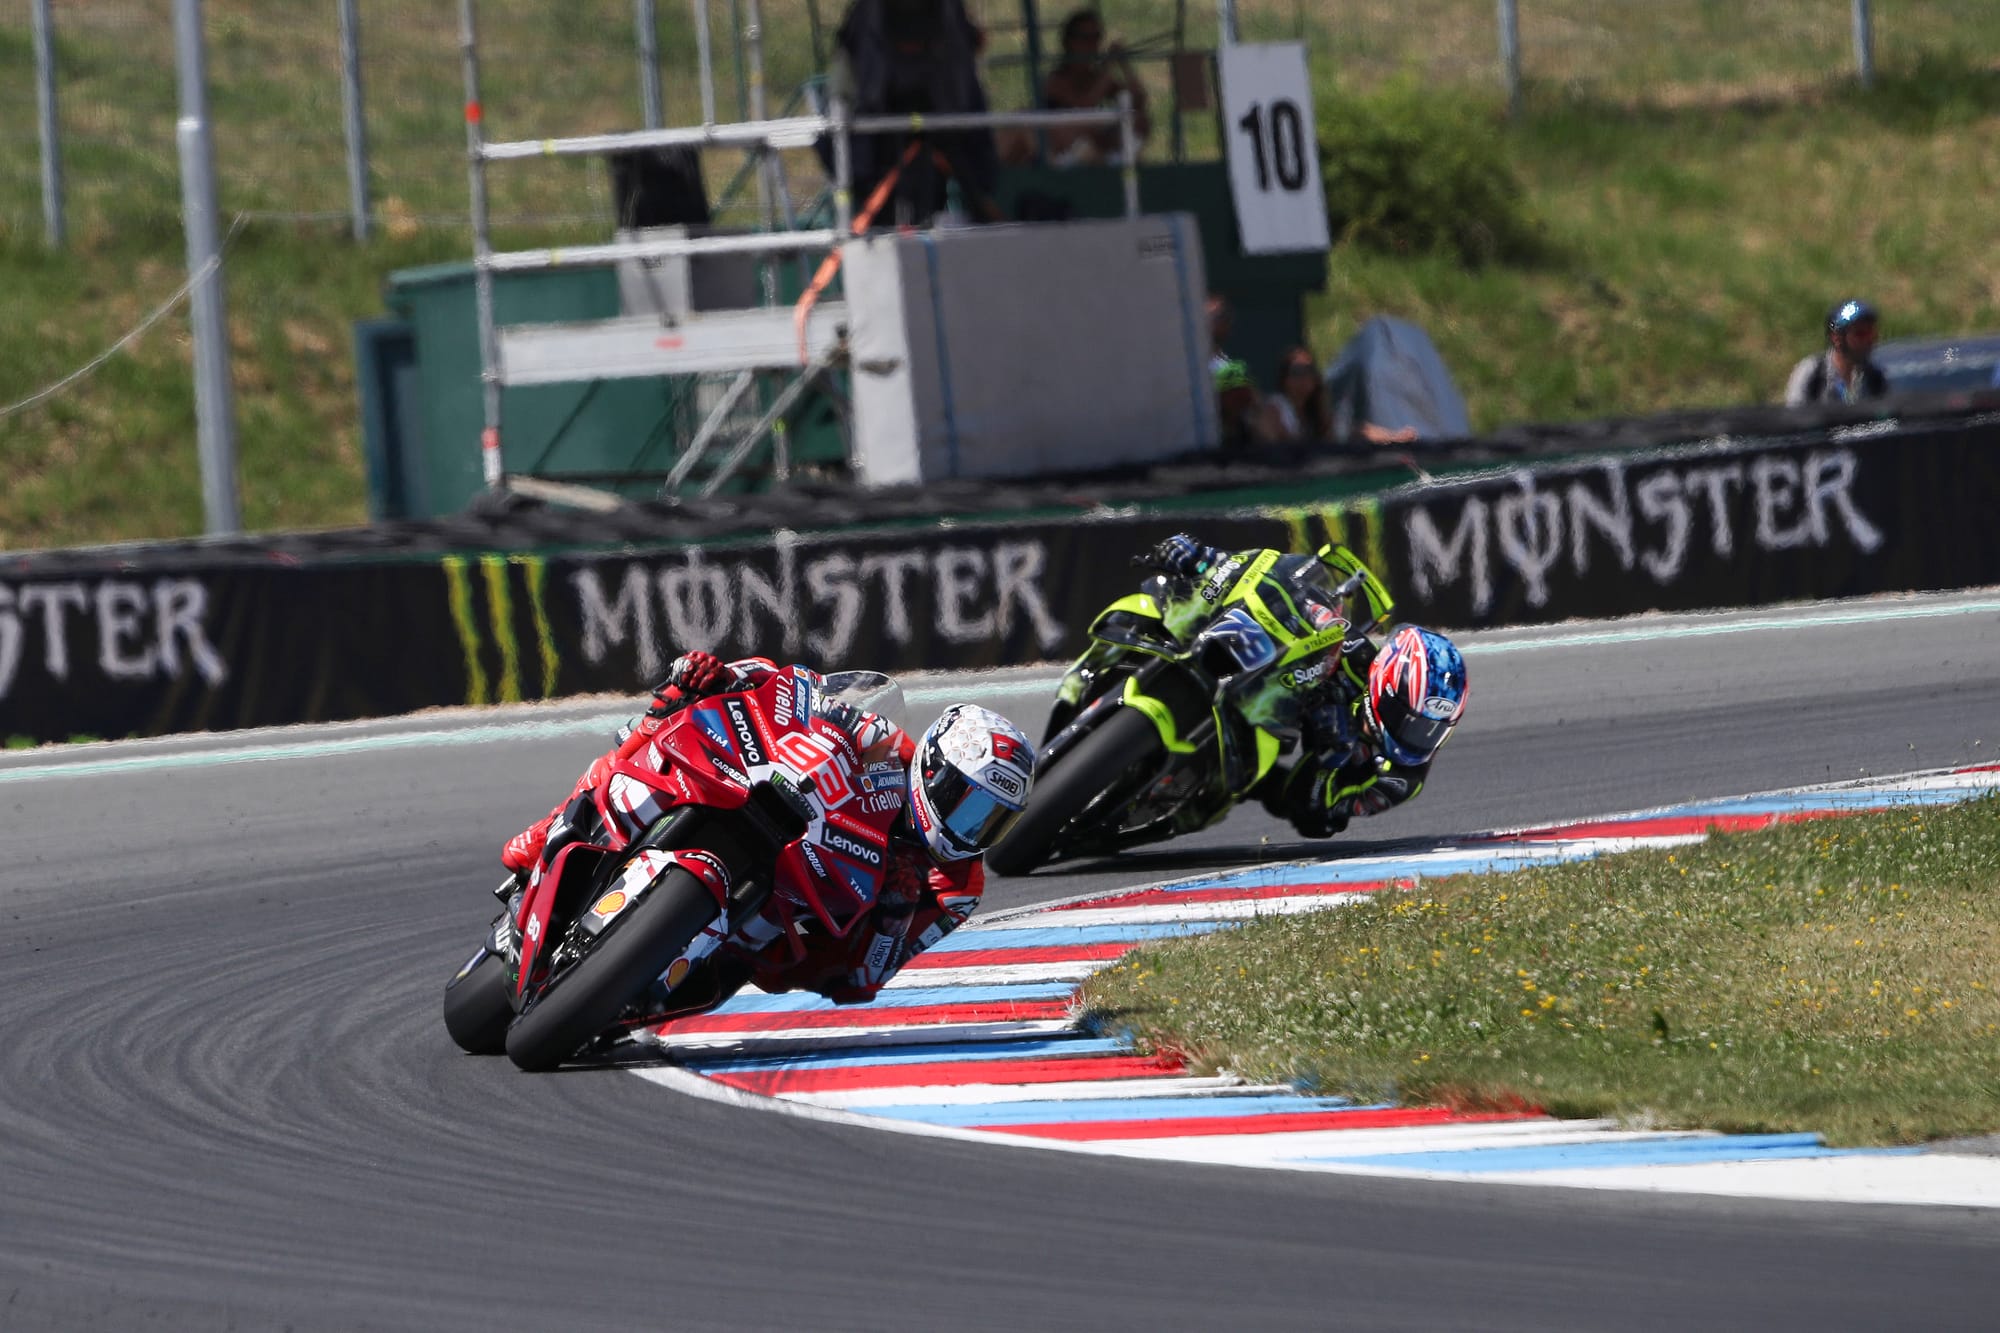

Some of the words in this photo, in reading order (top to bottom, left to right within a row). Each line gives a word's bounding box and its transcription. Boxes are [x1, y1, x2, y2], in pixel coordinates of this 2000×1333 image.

[1239, 101, 1309, 190] 10
[1404, 452, 1884, 616] MONSTER
[569, 530, 1068, 684] MONSTER
[773, 683, 795, 727] riello
[706, 727, 729, 748] TIM
[727, 701, 760, 763] Lenovo
[821, 724, 859, 766] VARGROUP
[711, 757, 753, 789] CARRERA
[778, 731, 856, 811] 93
[989, 771, 1019, 795] SHOEI
[868, 789, 903, 814] riello
[913, 790, 928, 828] Lenovo
[801, 840, 828, 878] CARRERA
[824, 828, 880, 864] Lenovo
[684, 852, 730, 898] Lenovo
[849, 877, 868, 901] TIM
